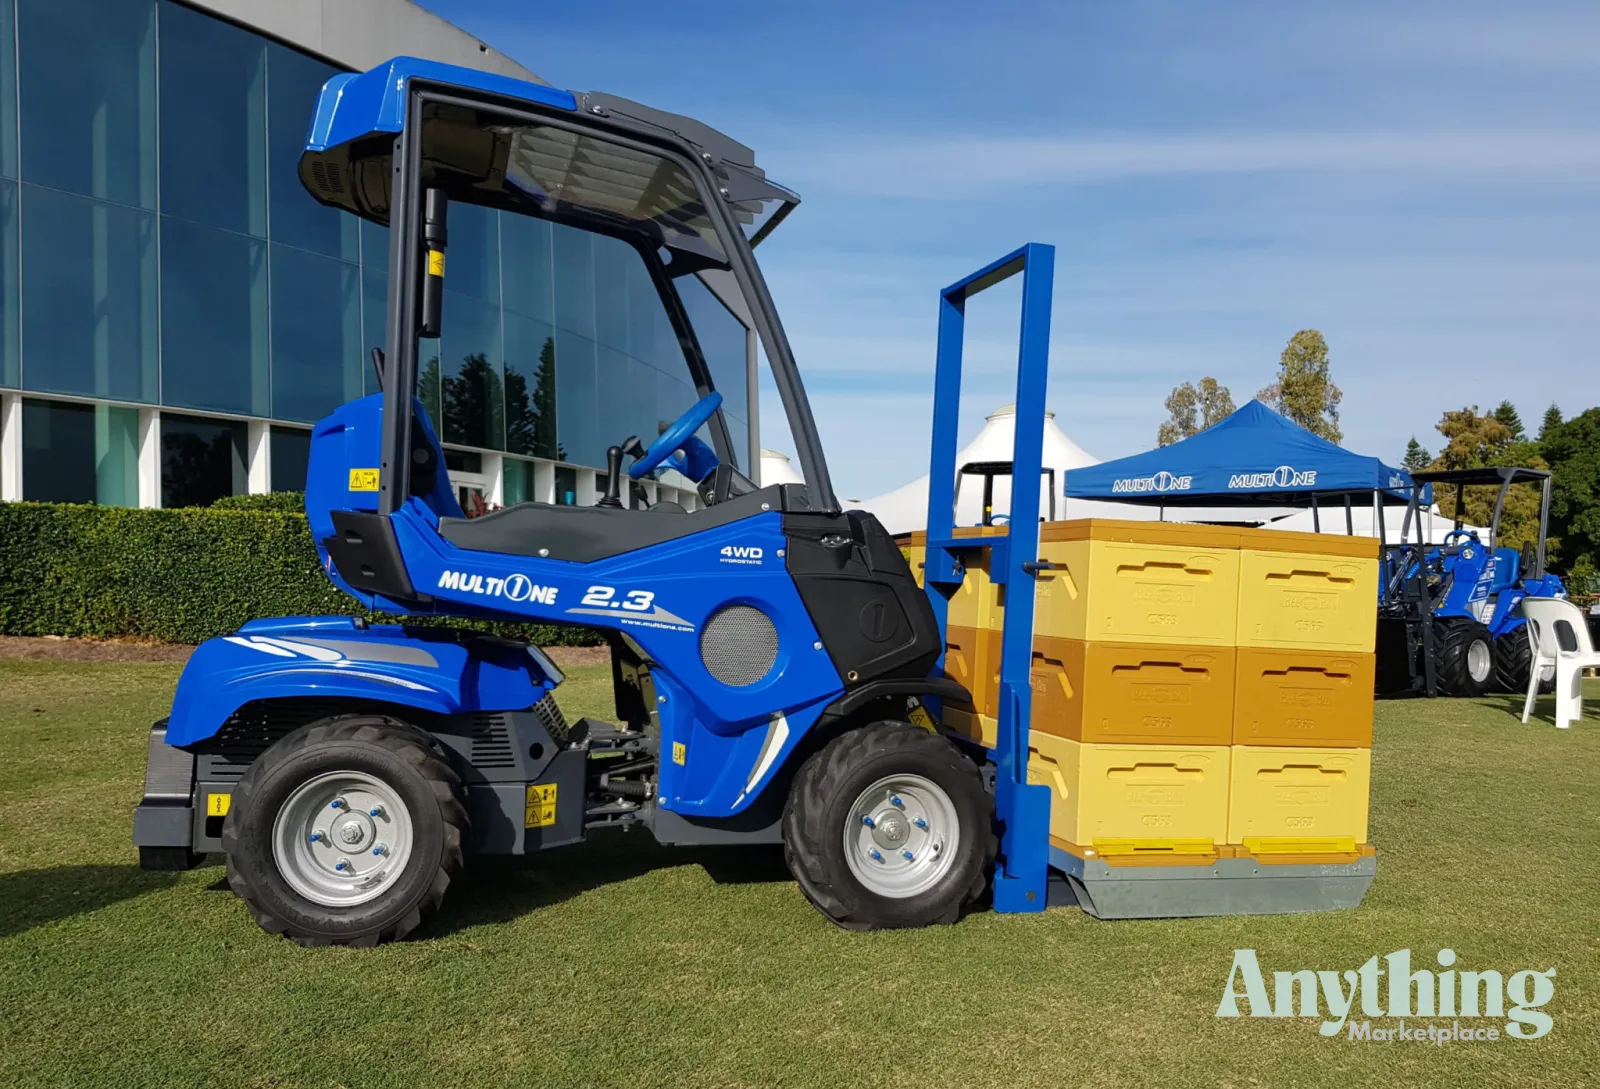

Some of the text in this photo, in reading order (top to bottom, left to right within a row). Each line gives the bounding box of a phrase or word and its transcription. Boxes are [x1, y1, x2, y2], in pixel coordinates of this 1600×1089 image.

[720, 546, 763, 558] 4WD
[581, 585, 655, 611] 2.3
[620, 618, 695, 633] www.multione.com
